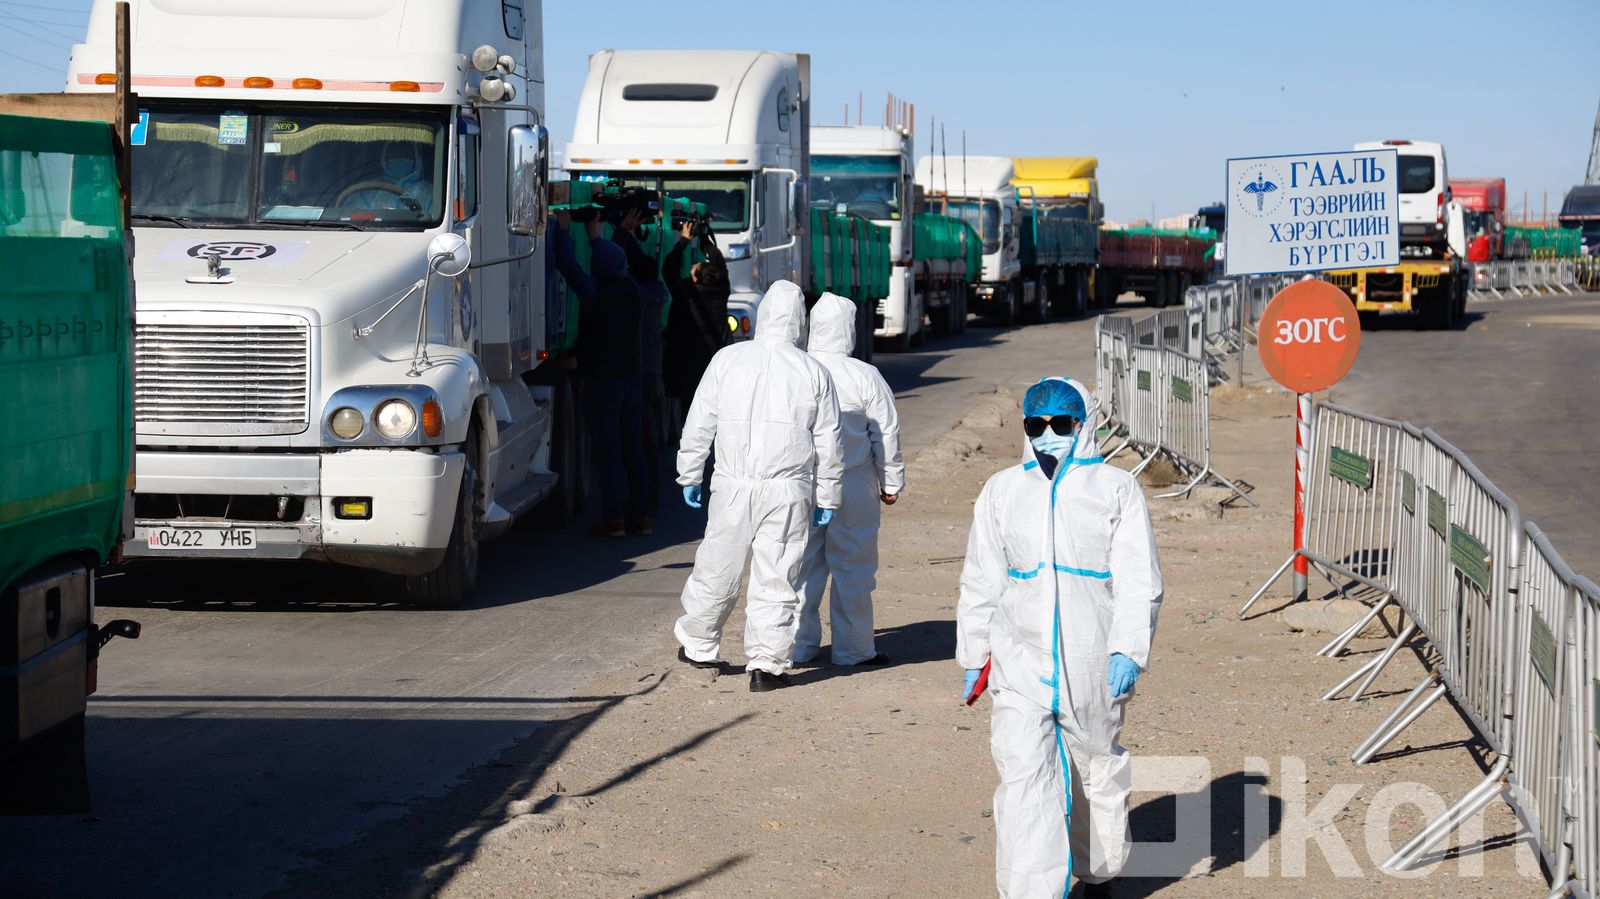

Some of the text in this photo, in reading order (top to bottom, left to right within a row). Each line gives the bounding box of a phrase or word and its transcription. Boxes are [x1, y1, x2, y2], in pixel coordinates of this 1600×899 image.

[1290, 157, 1386, 188] ГААЛЬ
[1289, 191, 1386, 217] ТЭЭВРИЙН
[1268, 215, 1390, 243] ХЭРЭГСЛИЙН
[1289, 241, 1386, 266] БҮРТГЭЛ
[1273, 316, 1346, 345] ЗОГС
[159, 530, 252, 546] 0422 УНБ
